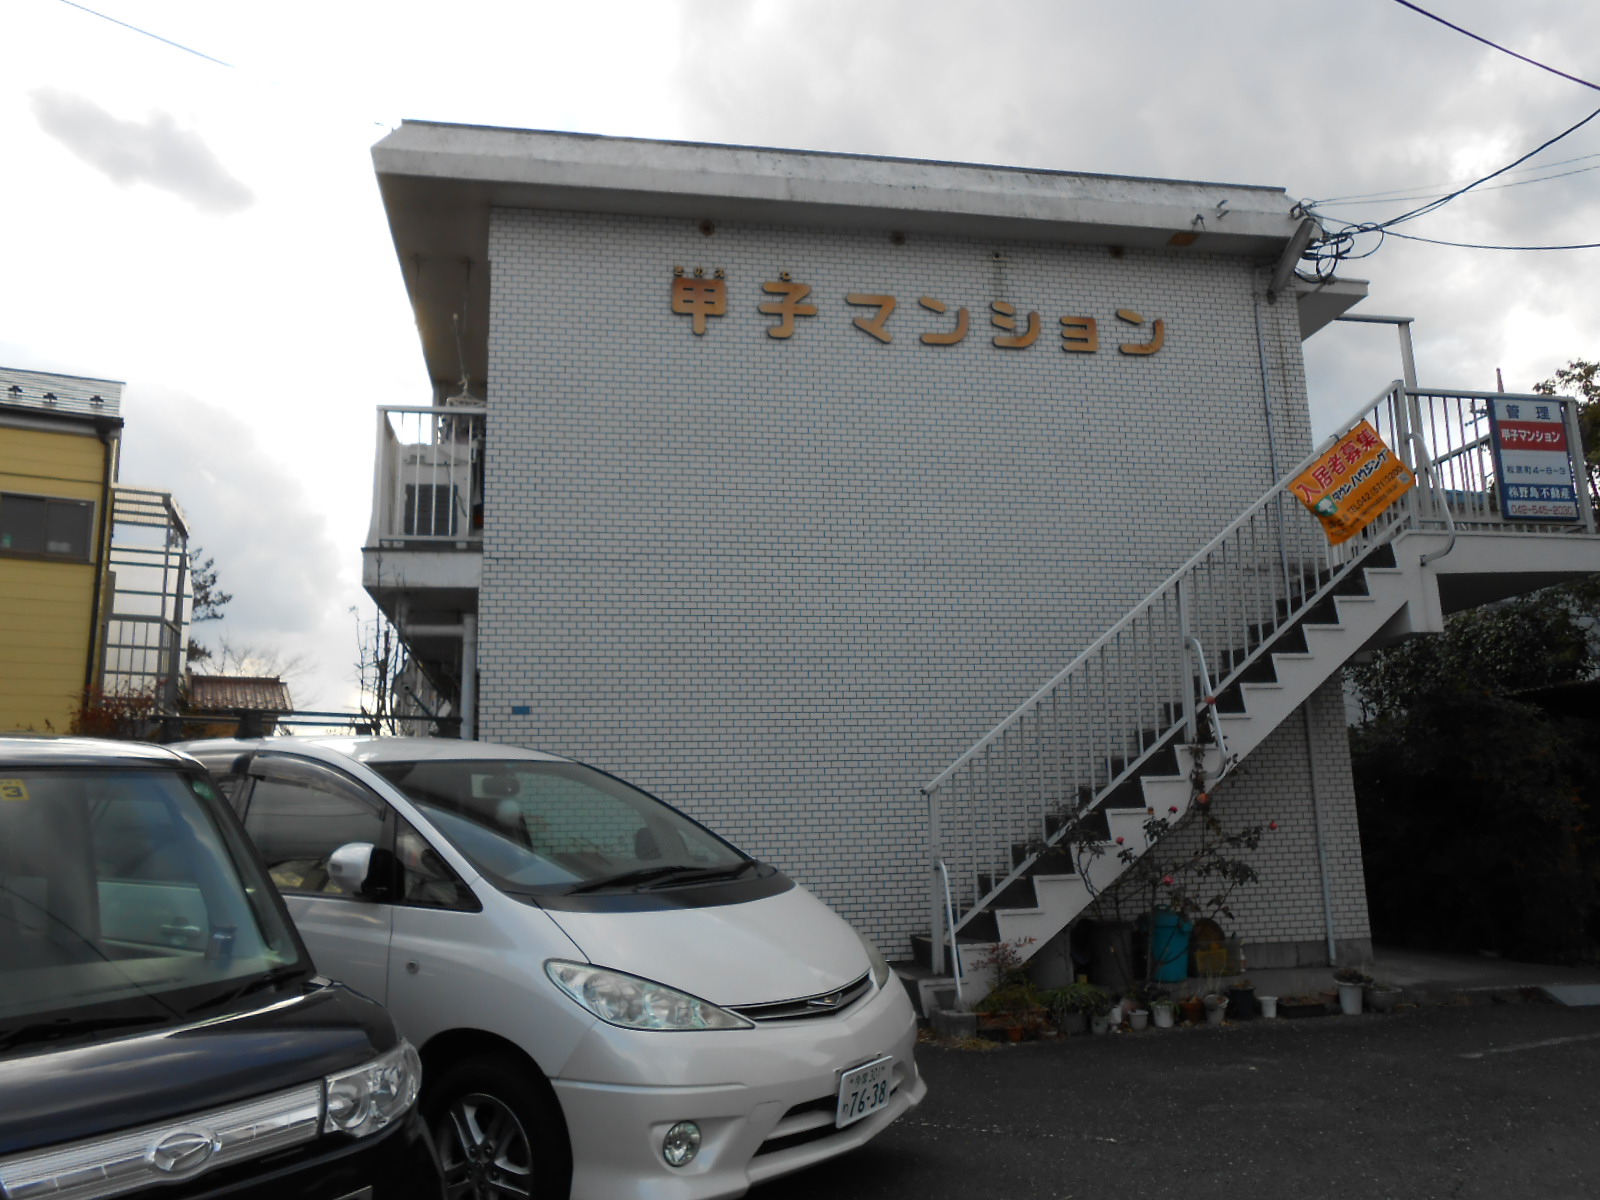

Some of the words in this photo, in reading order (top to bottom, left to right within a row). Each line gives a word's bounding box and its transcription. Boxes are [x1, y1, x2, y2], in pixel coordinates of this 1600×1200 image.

[671, 277, 1166, 356] 甲子マンション
[1501, 428, 1561, 443] 甲子マンション
[1505, 404, 1551, 420] 管理
[1296, 429, 1379, 504] 入居者募集
[1332, 448, 1390, 502] タウンハウジング
